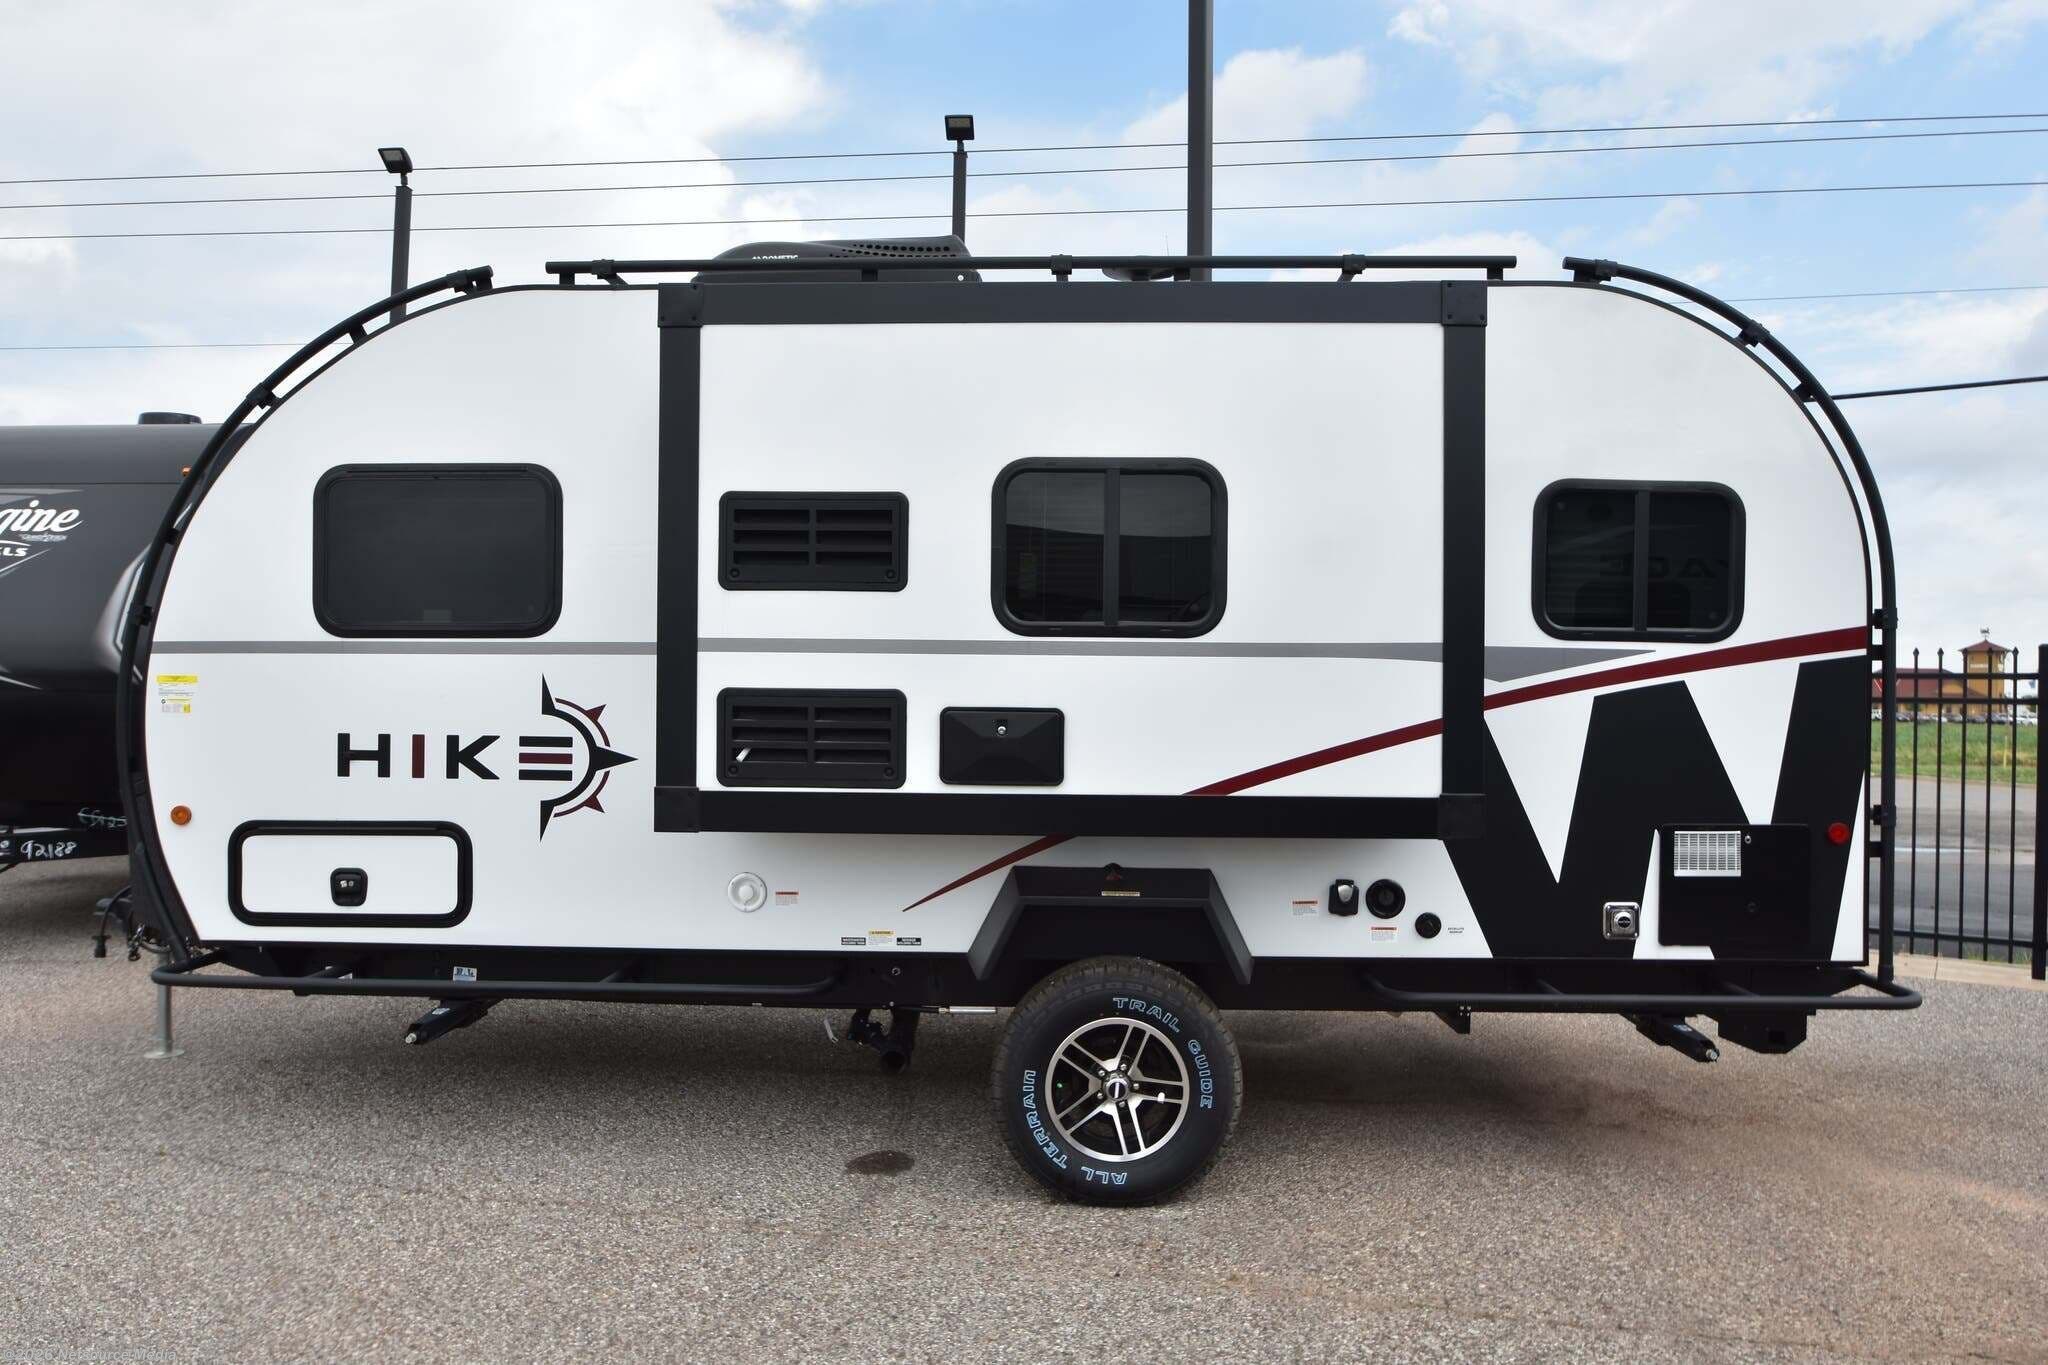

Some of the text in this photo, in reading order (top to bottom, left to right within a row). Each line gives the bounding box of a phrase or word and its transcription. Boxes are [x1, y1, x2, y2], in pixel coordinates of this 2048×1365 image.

[337, 732, 573, 782] HIKE
[20, 840, 78, 860] 92188
[1113, 997, 1218, 1110] TRAIL GUIDE
[1022, 1069, 1128, 1185] ALL TERRAIN
